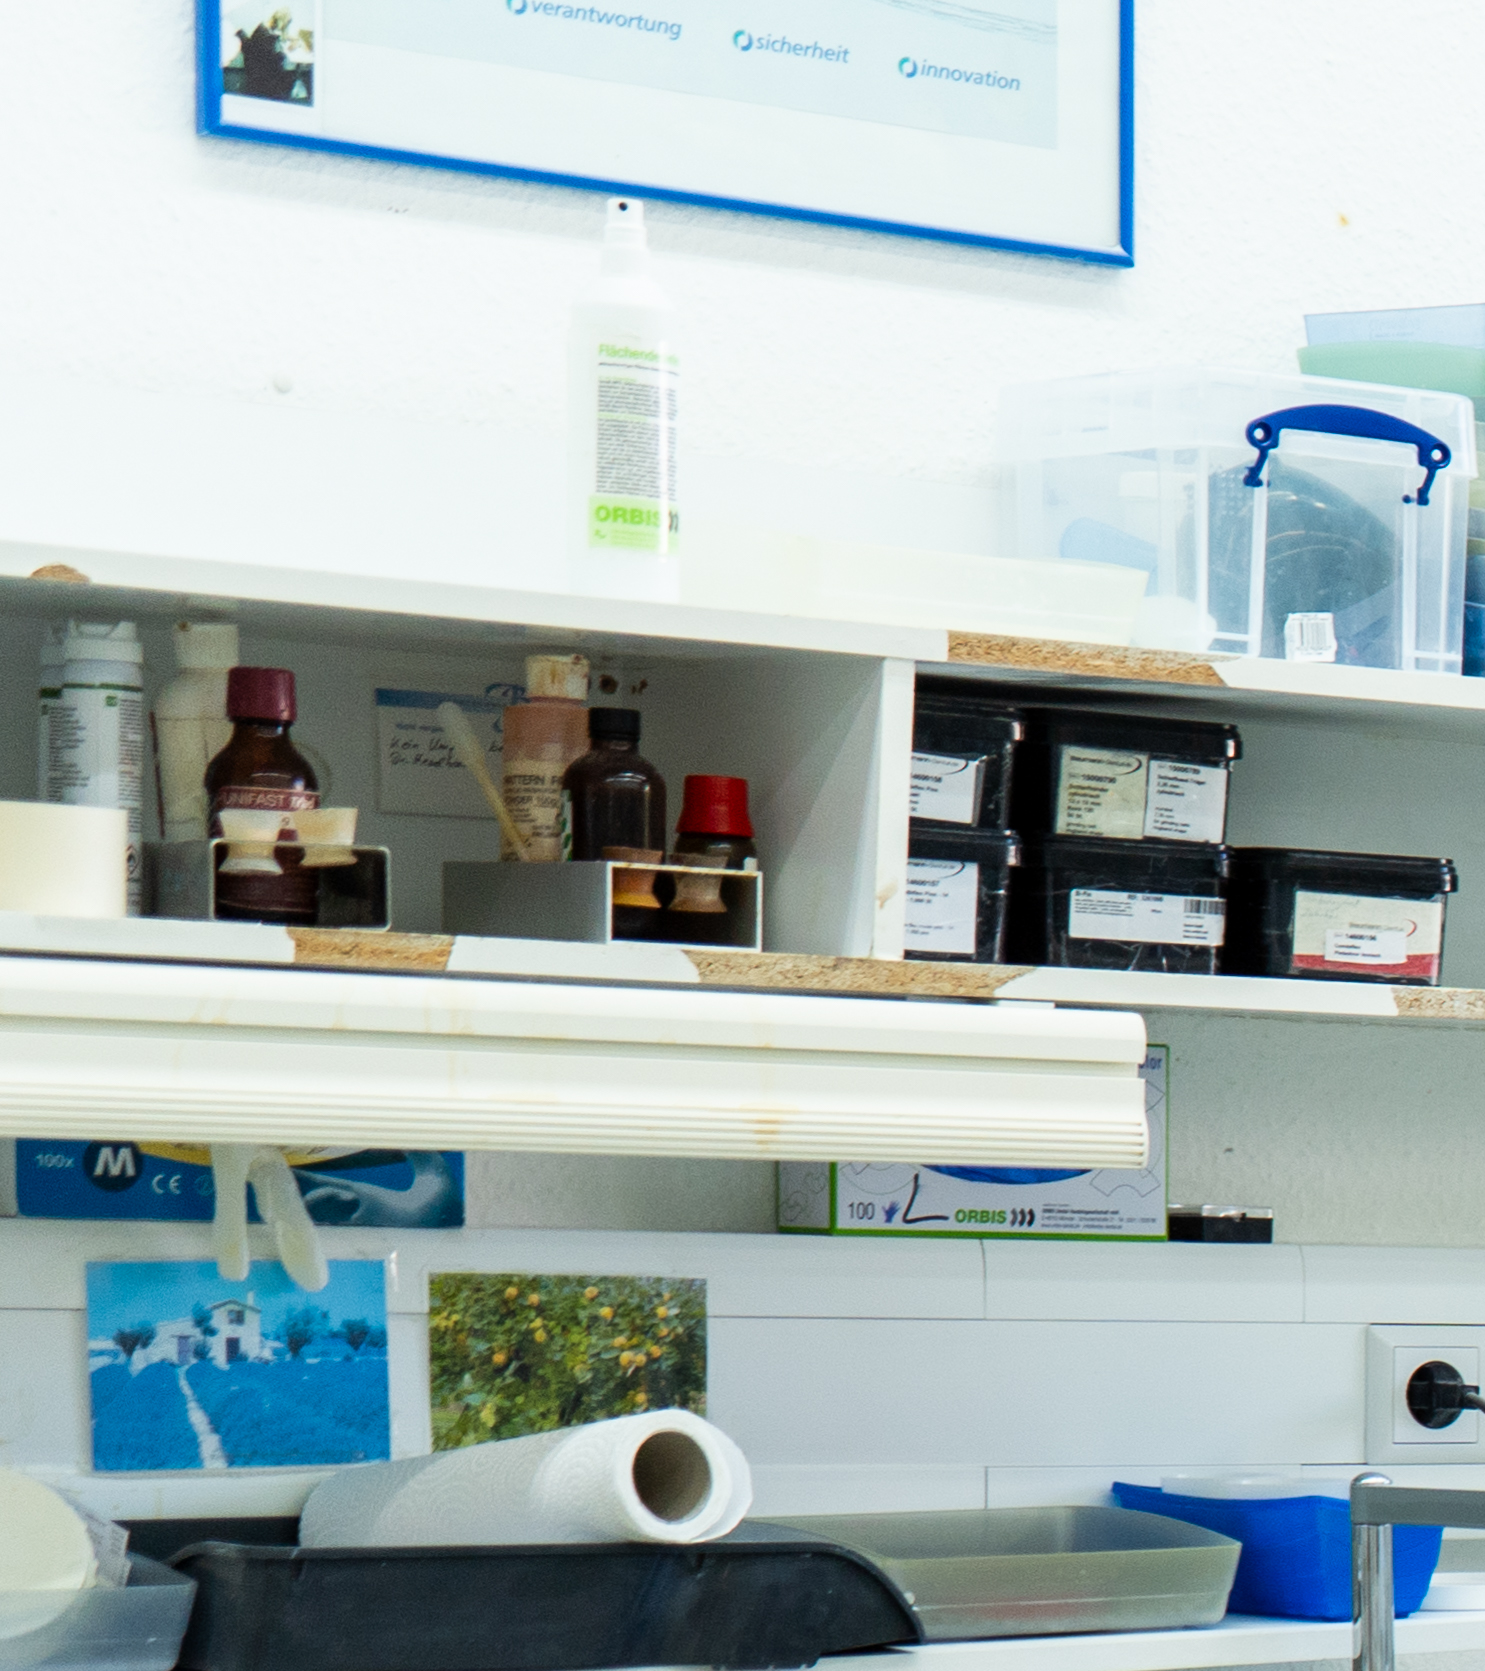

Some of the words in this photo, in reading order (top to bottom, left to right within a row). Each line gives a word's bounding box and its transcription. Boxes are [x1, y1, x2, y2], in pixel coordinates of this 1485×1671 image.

[531, 0, 683, 40] verantwortung
[755, 34, 850, 64] sicherheit
[919, 60, 1022, 91] innovation
[594, 505, 661, 527] ORBIS
[34, 1153, 75, 1169] 100x
[93, 1146, 137, 1179] M
[847, 1201, 875, 1220] 100
[954, 1208, 1007, 1224] ORBIS
